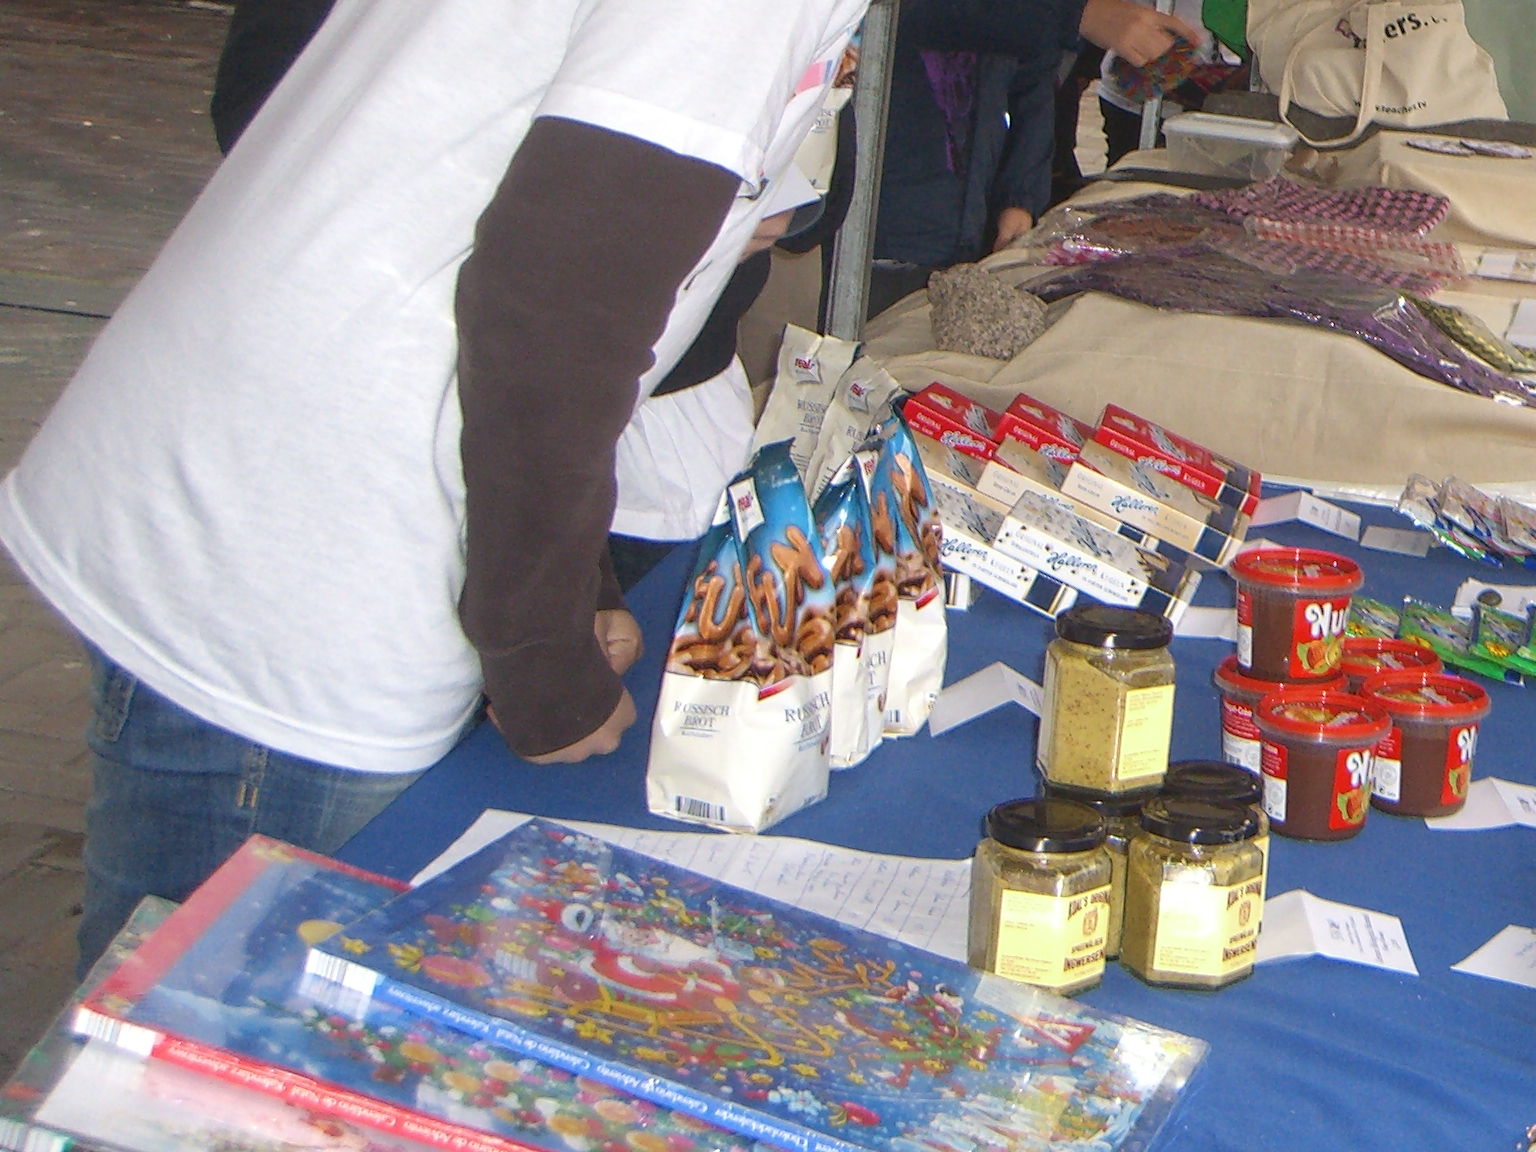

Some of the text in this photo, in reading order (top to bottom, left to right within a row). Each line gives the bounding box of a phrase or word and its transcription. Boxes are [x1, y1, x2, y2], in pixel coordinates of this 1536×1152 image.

[1046, 551, 1098, 574] Halloren
[674, 701, 730, 716] RUSSISCH
[684, 716, 717, 728] BROT
